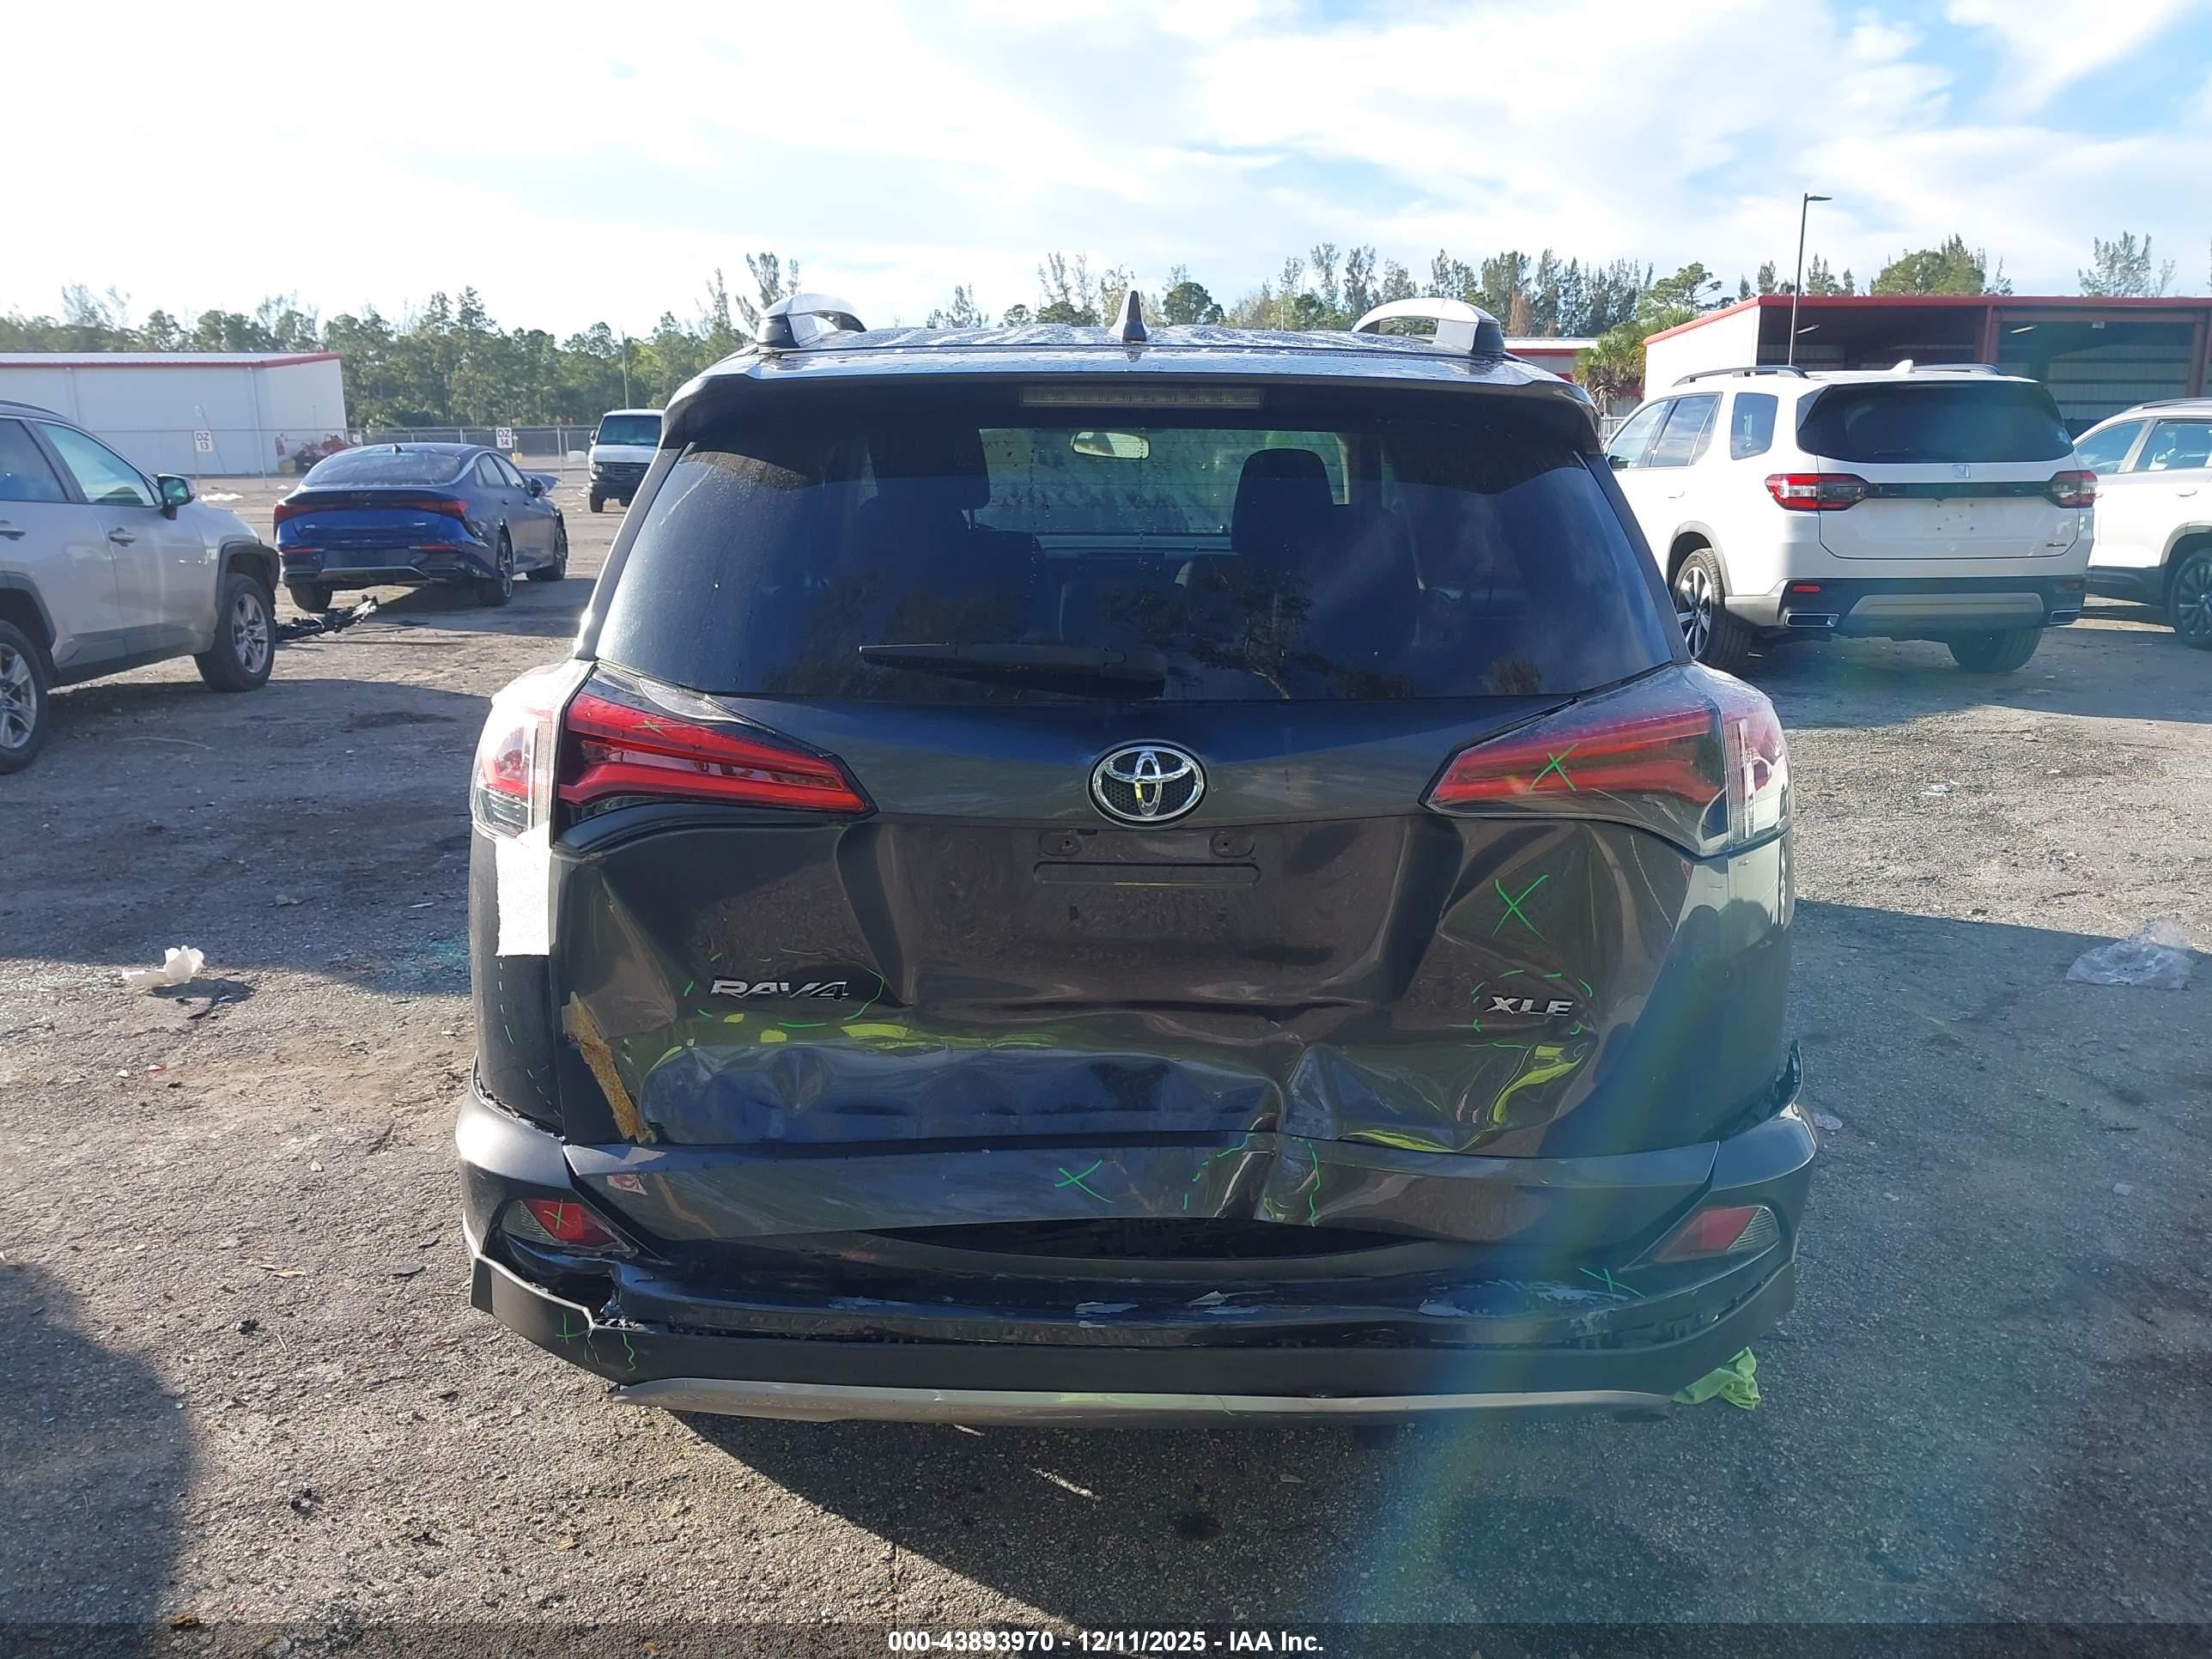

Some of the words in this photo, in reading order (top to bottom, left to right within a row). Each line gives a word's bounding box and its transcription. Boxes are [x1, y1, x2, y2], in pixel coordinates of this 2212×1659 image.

[196, 432, 210, 441] DZ
[497, 429, 510, 438] DZ
[199, 441, 210, 451] 13
[710, 979, 849, 1002] RAV4
[1484, 995, 1574, 1017] XLE
